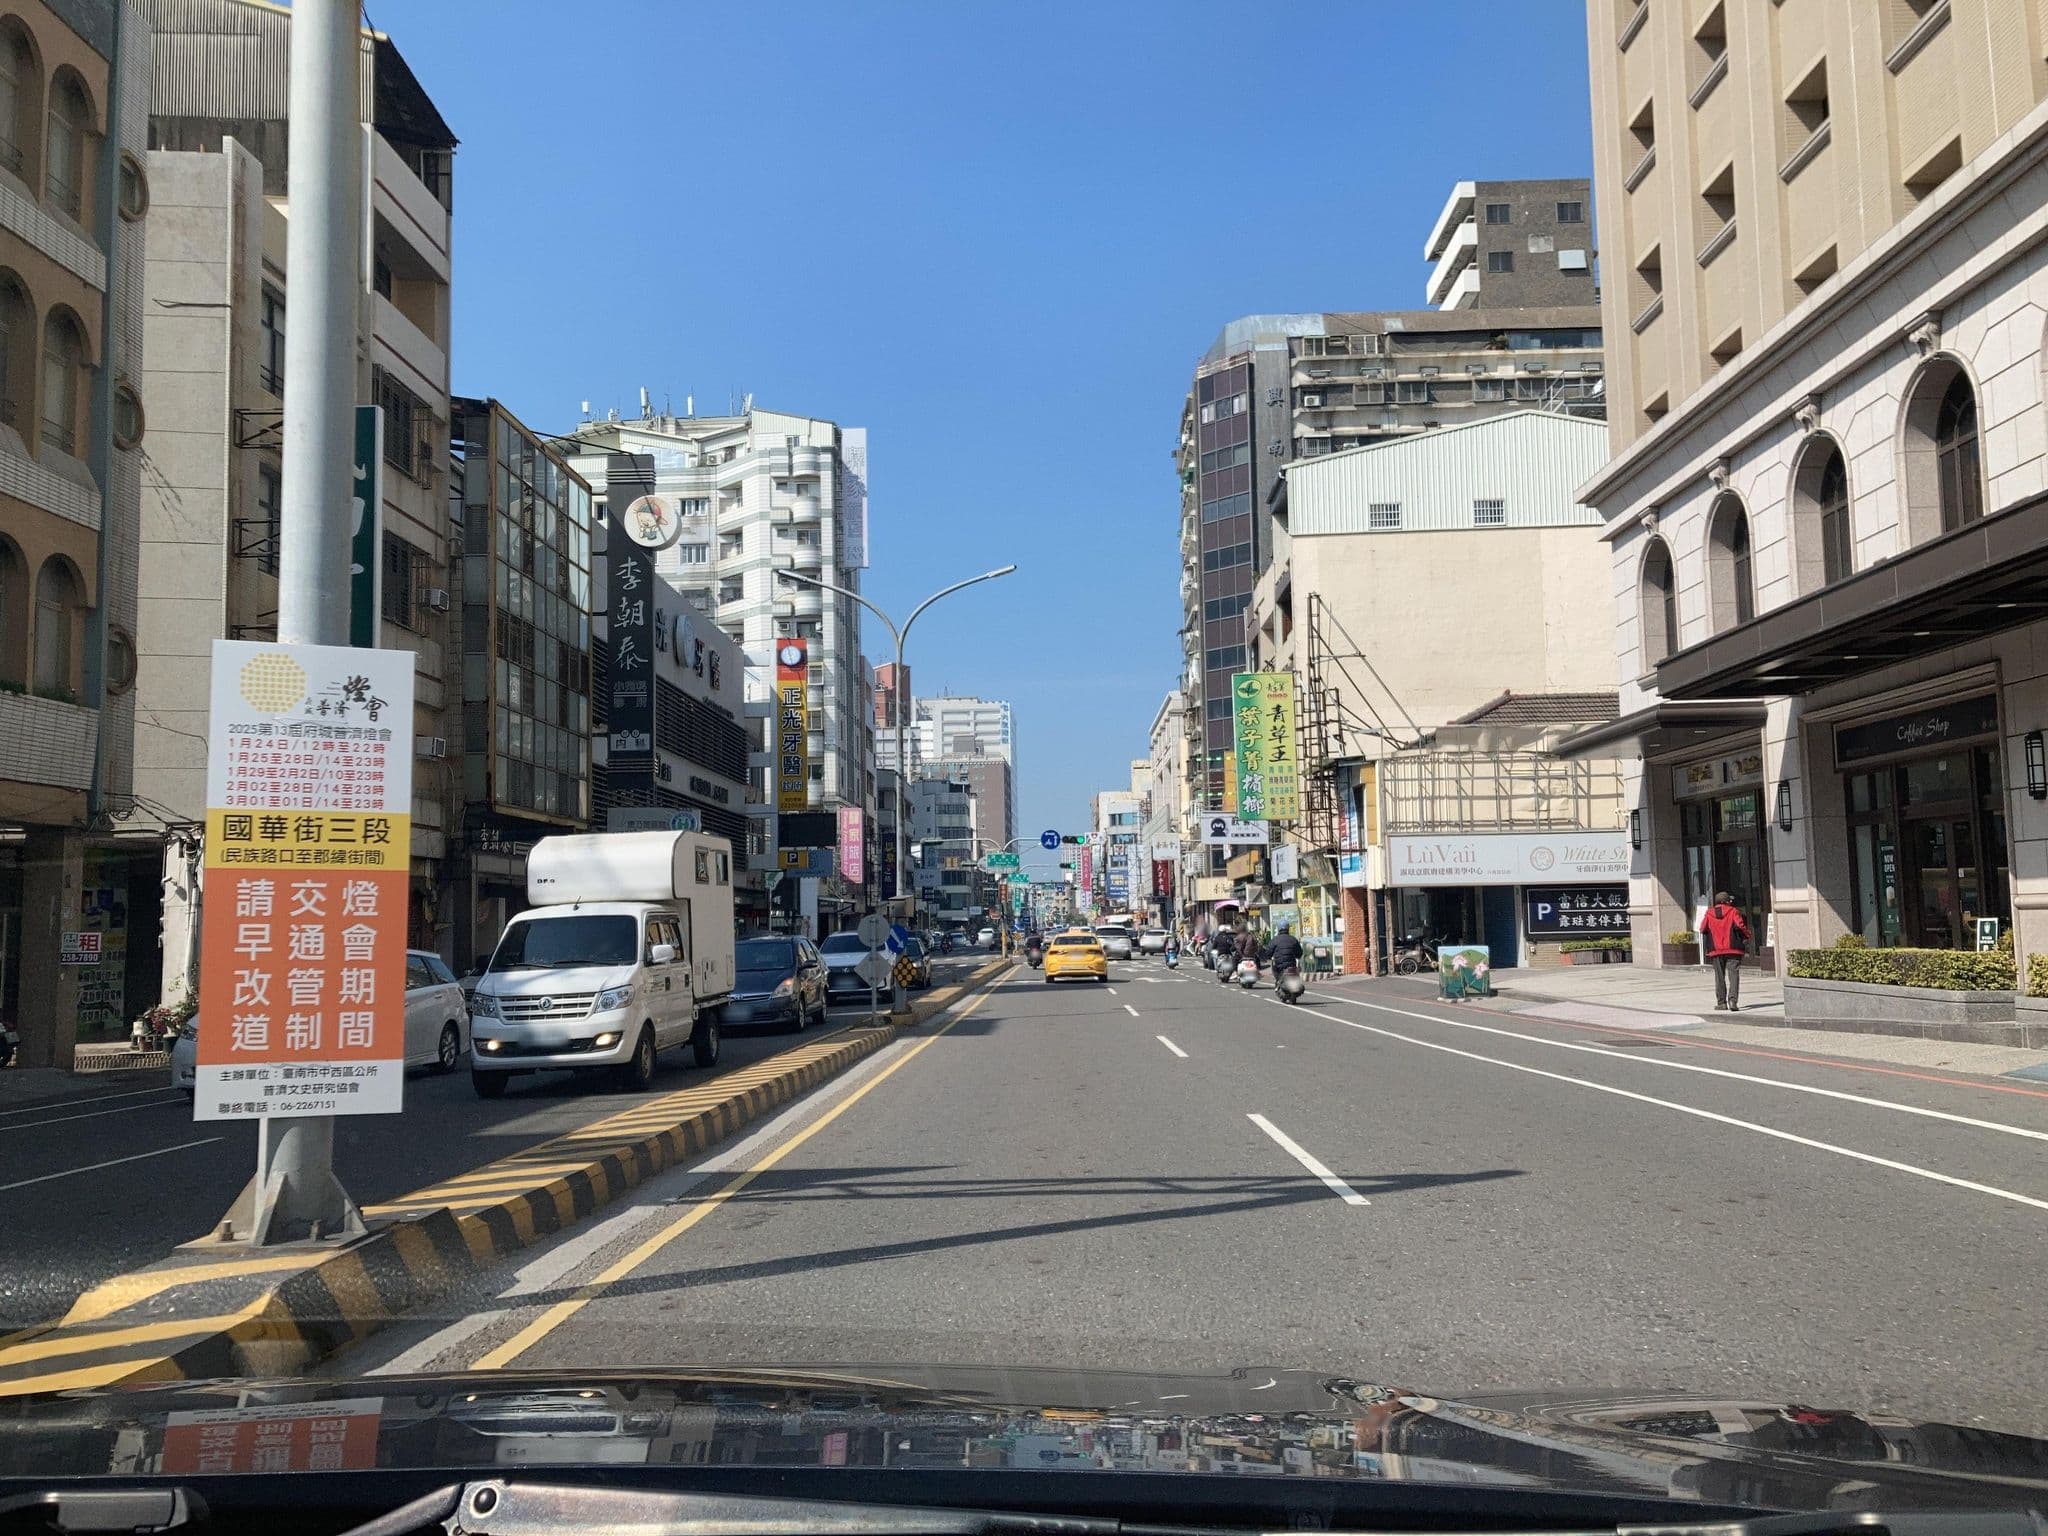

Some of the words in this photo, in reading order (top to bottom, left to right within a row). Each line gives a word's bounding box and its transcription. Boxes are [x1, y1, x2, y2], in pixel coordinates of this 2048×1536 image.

[614, 555, 649, 671] 李朝泰
[1266, 704, 1291, 763] 青草王
[1897, 722, 1924, 743] Coffee
[1925, 717, 1950, 737] Shop
[228, 752, 385, 768] 1月25至28日/14至23時
[222, 814, 392, 844] 國華街三段
[1562, 845, 1606, 860] White
[1537, 903, 1551, 920] P
[80, 934, 99, 951] 租
[231, 879, 275, 1052] 請早改道
[285, 879, 327, 1051] 交通管制
[338, 880, 379, 1049] 燈會期間
[263, 1083, 360, 1096] 普濟文史研究協會
